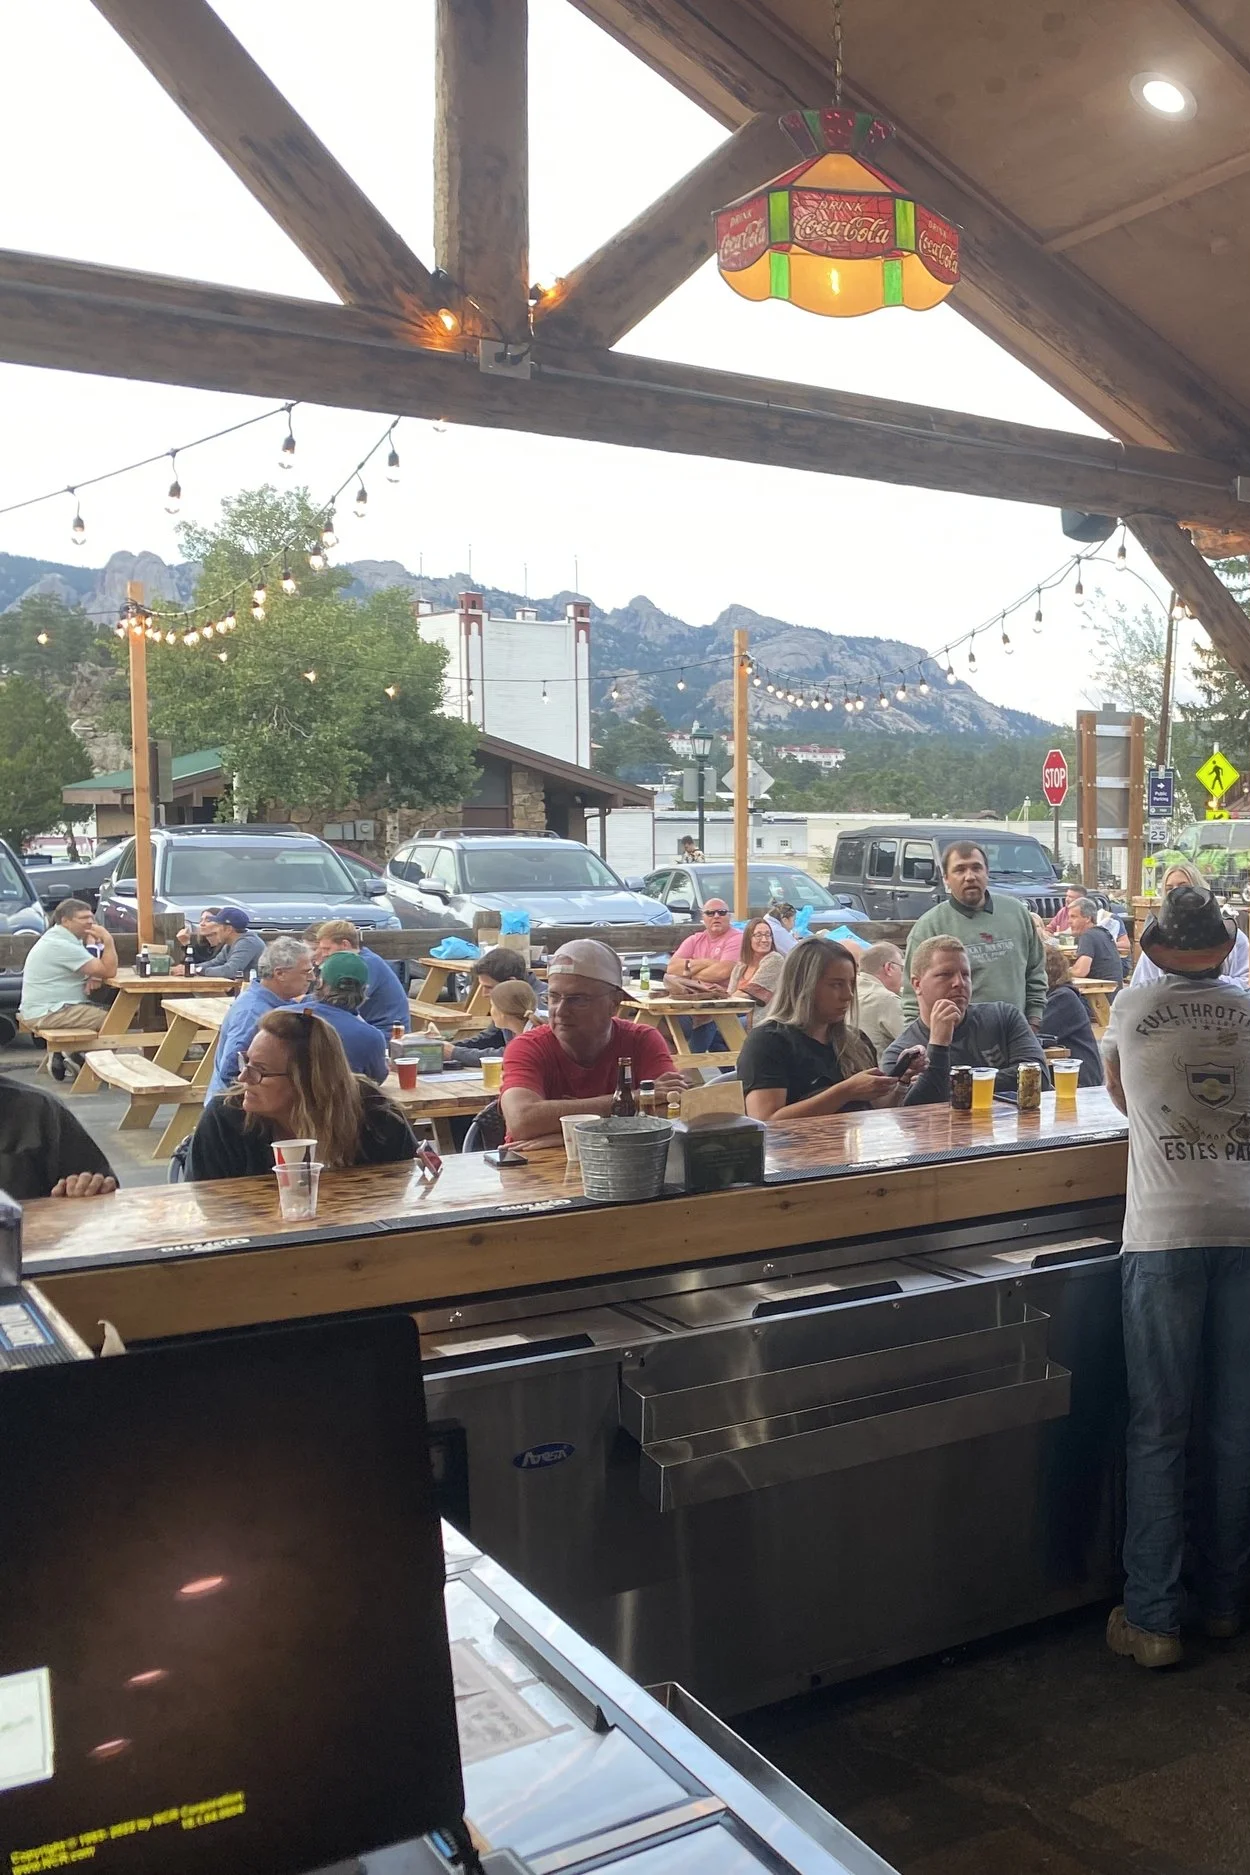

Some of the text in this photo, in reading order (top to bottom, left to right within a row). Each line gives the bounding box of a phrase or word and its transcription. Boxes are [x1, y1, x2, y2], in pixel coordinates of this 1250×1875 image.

[818, 200, 866, 213] DRINK
[794, 213, 890, 244] Coca-Cola
[1045, 767, 1066, 789] STOP
[1150, 831, 1166, 841] 25
[1136, 1005, 1178, 1037] FULL
[1164, 1142, 1218, 1161] ESTES
